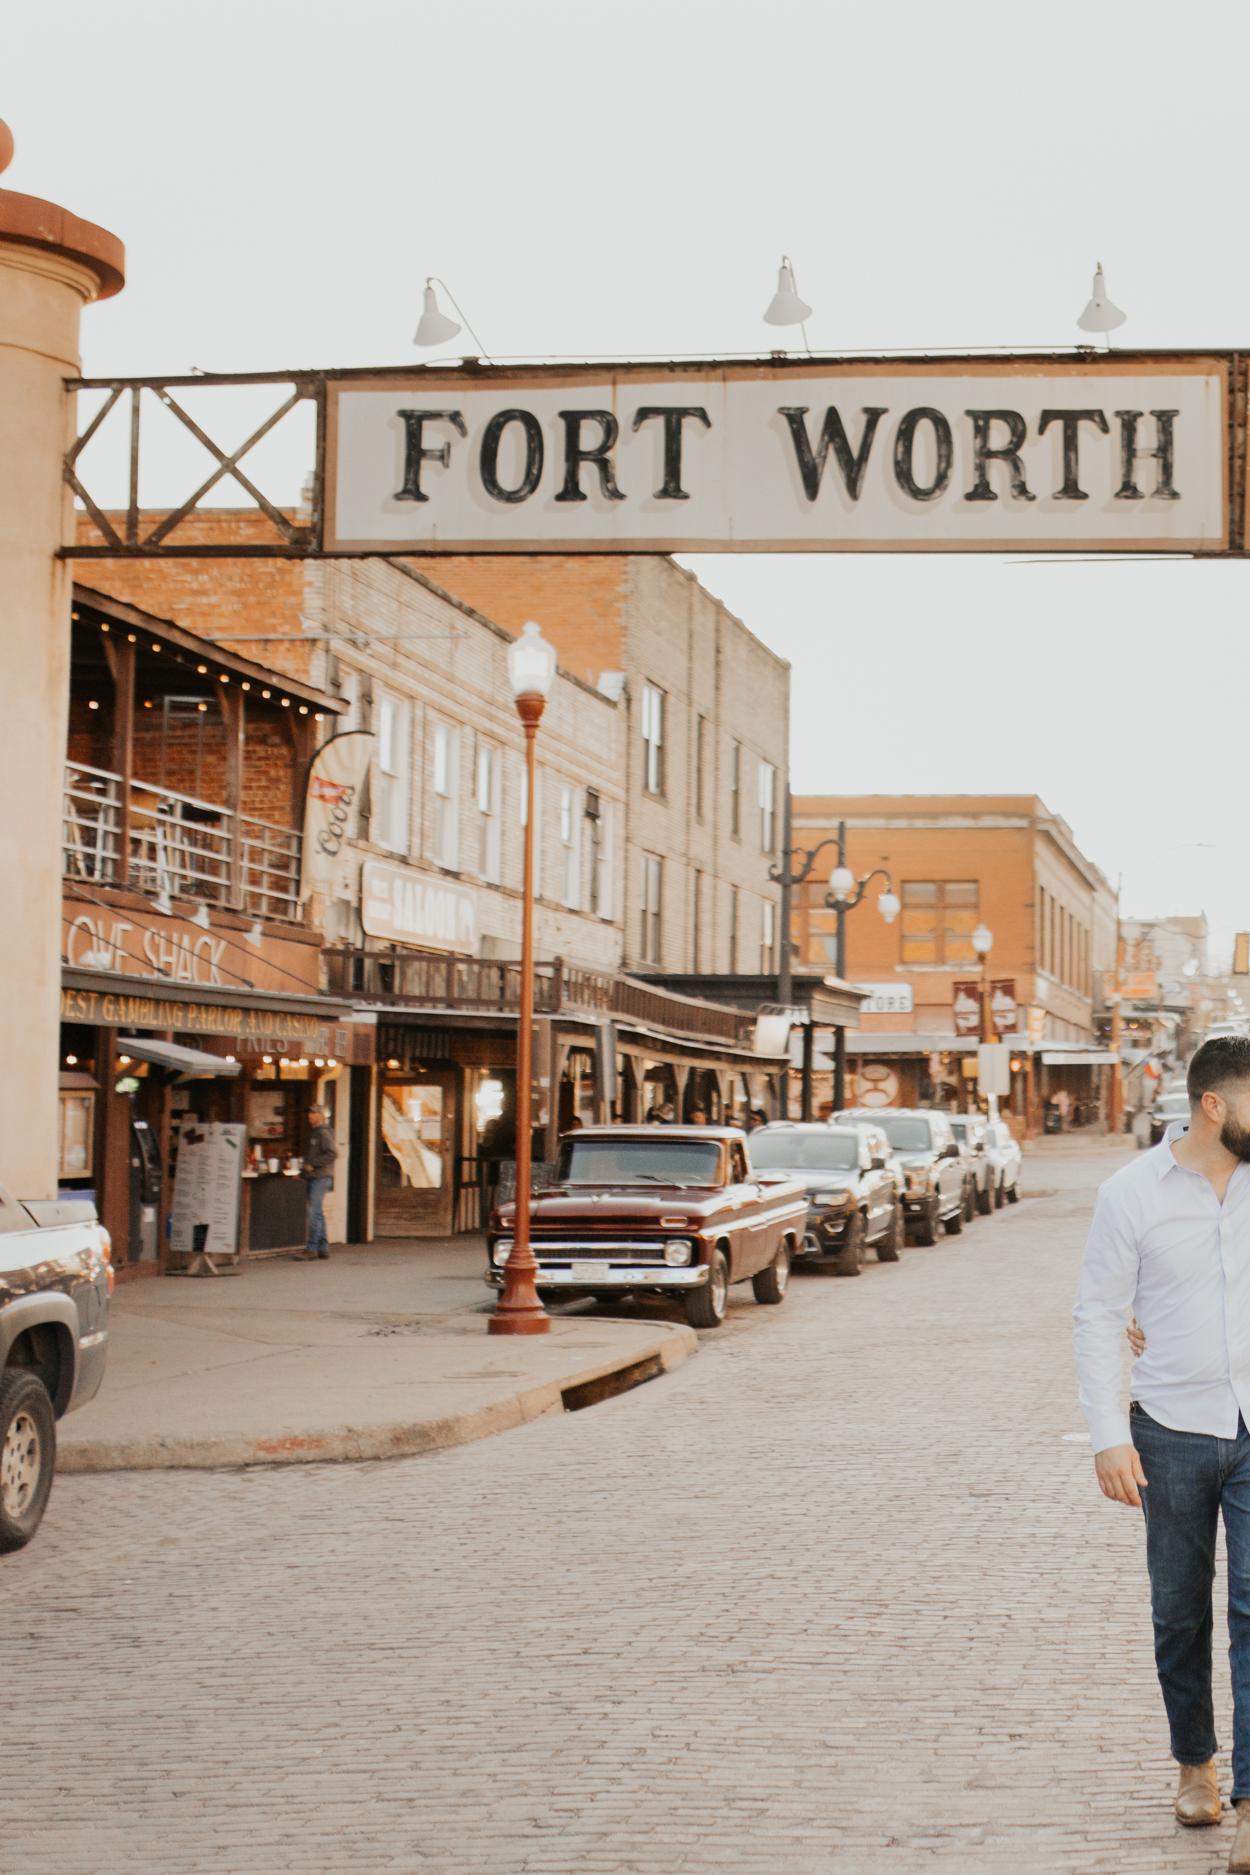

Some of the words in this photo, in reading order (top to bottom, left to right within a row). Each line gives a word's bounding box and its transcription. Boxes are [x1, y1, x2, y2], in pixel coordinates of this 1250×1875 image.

[393, 406, 713, 504] FORT
[777, 404, 1182, 504] WORTH
[316, 785, 355, 857] Coors
[143, 928, 227, 987] SHACK
[102, 995, 184, 1027] GAMBLING
[186, 1003, 242, 1033] PARLOR
[246, 1010, 274, 1035] AND
[276, 1013, 319, 1038] CASINO
